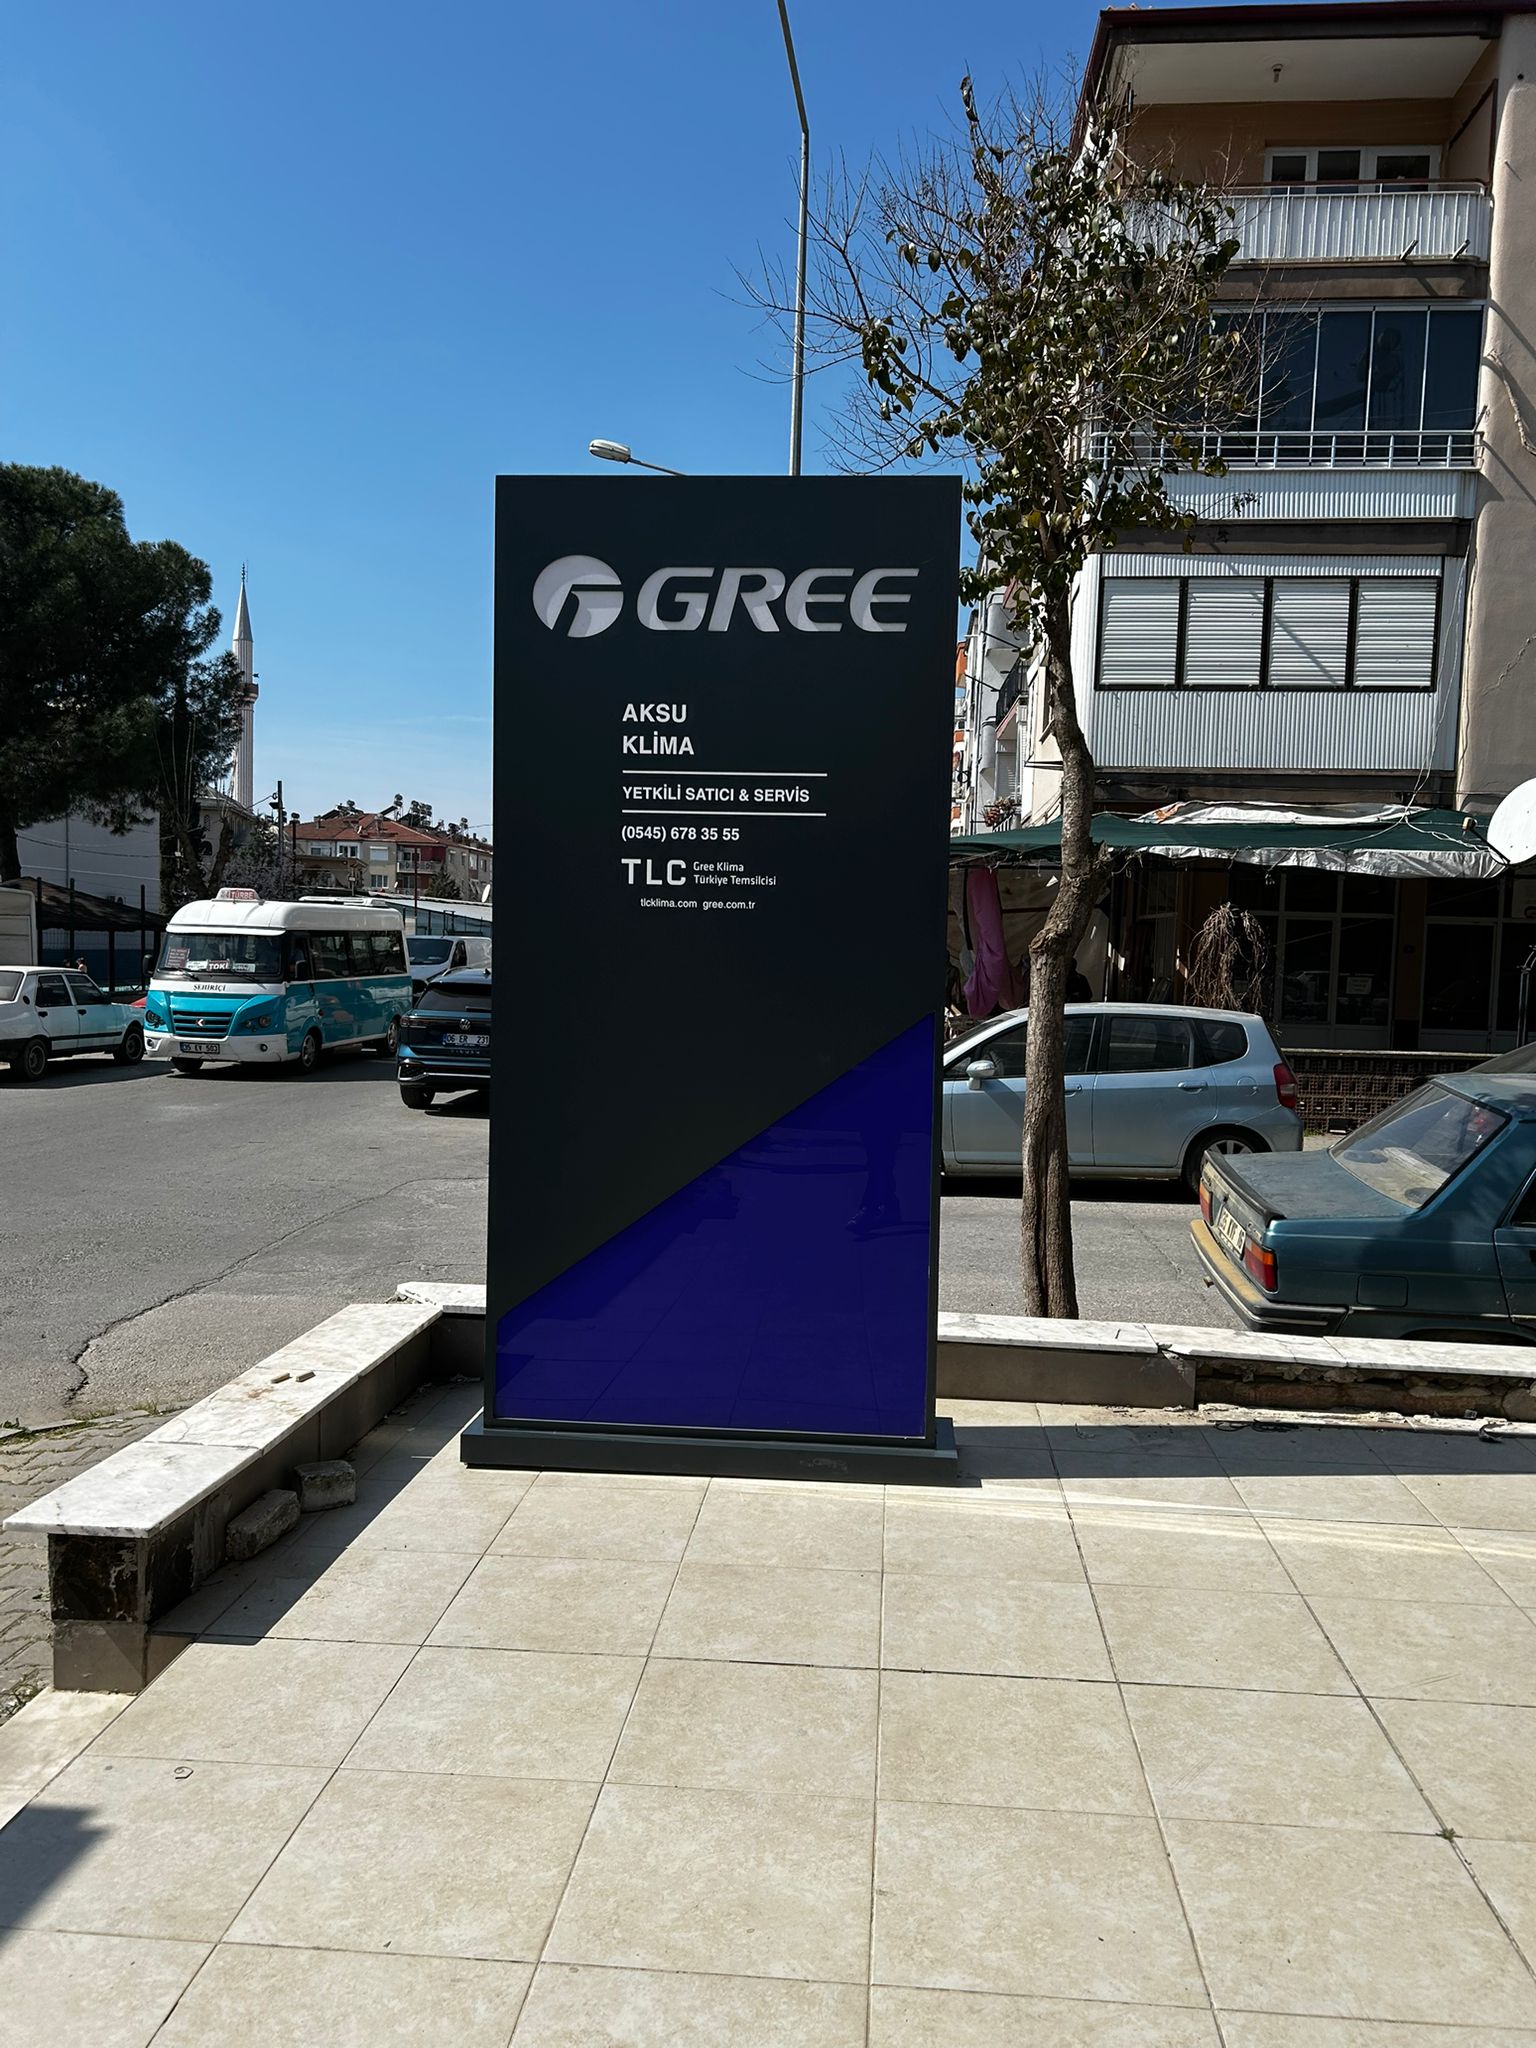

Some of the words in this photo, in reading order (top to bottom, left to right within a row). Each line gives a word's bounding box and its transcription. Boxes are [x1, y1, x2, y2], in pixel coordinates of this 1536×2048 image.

[637, 567, 920, 632] GREE
[622, 703, 687, 723] AKSU
[622, 731, 695, 755] KLİMA
[622, 784, 681, 800] YETKİLİ
[685, 787, 734, 801] SATICI
[738, 788, 750, 802] &
[753, 785, 810, 803] SERVİS
[621, 825, 667, 842] (0545)
[670, 827, 697, 840] 678
[700, 828, 718, 841] 35
[722, 828, 740, 841] 55
[621, 858, 687, 886] TLC
[693, 861, 715, 871] Gree
[716, 861, 744, 872] Klima
[693, 874, 728, 886] Türkiye
[730, 875, 776, 886] Temsilcisi
[640, 898, 698, 909] tlcklima.com
[702, 900, 756, 911] gree.com.tr
